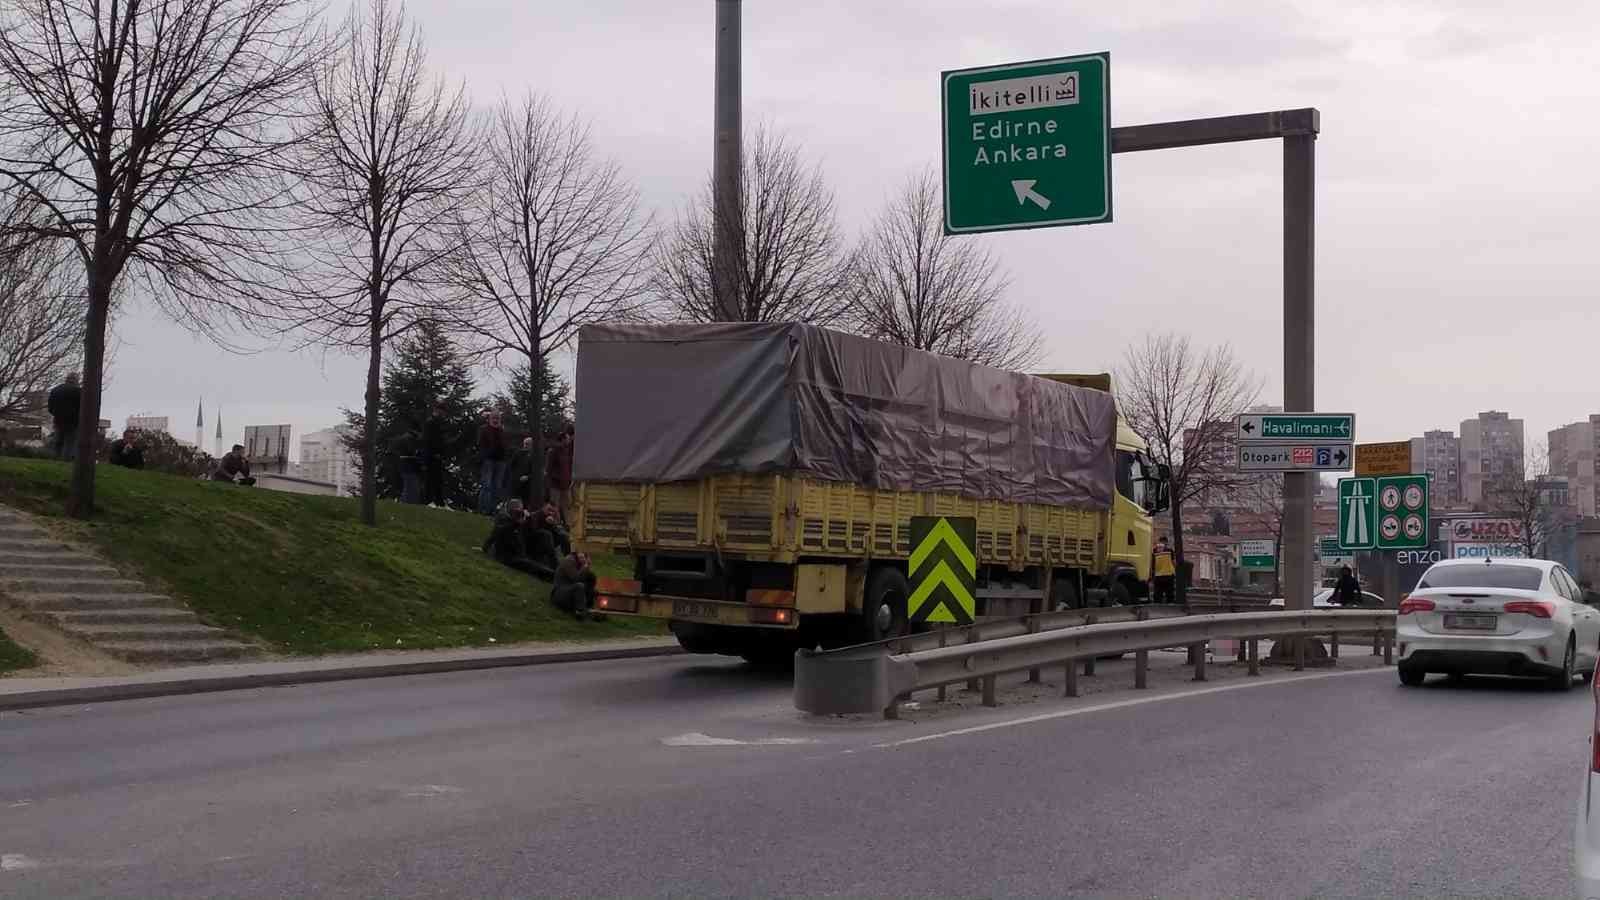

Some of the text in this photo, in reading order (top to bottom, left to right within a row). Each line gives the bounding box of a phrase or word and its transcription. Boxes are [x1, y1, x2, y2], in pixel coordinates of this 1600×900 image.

[972, 86, 1050, 110] İkitelli
[972, 119, 1058, 141] Edirne
[974, 143, 1067, 166] Ankara
[1263, 420, 1332, 434] Havalimanı
[1242, 451, 1290, 464] Otopark
